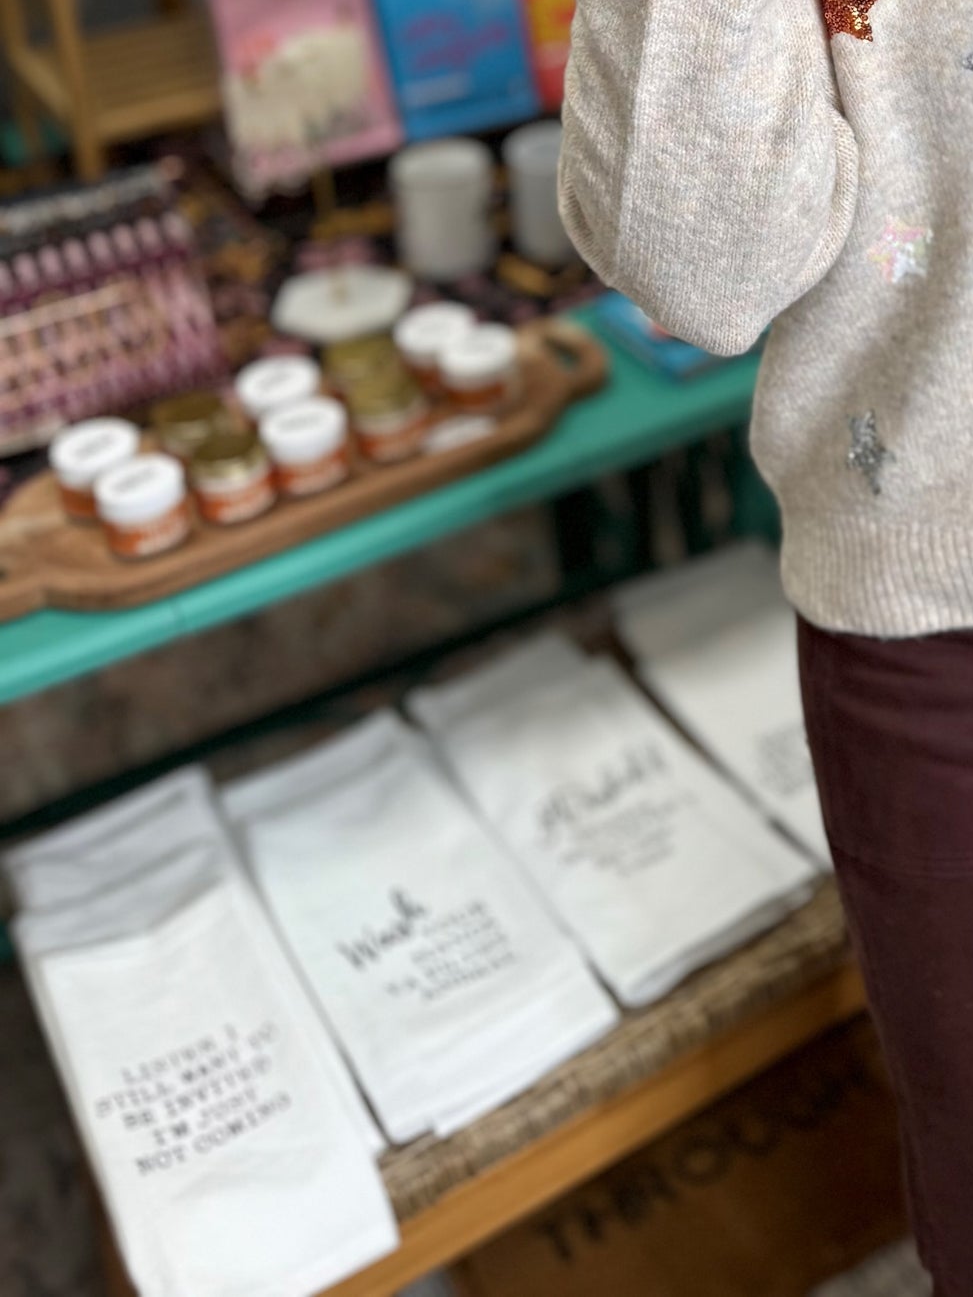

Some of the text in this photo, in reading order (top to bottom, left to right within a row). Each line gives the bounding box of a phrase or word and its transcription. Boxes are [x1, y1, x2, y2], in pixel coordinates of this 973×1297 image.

[95, 1083, 174, 1118] STILL
[181, 1047, 239, 1085] WANT
[121, 1036, 216, 1085] LISTEN
[123, 1053, 272, 1131] BE INVITED
[136, 1091, 292, 1177] NOT COMING
[198, 1088, 258, 1129] JUST
